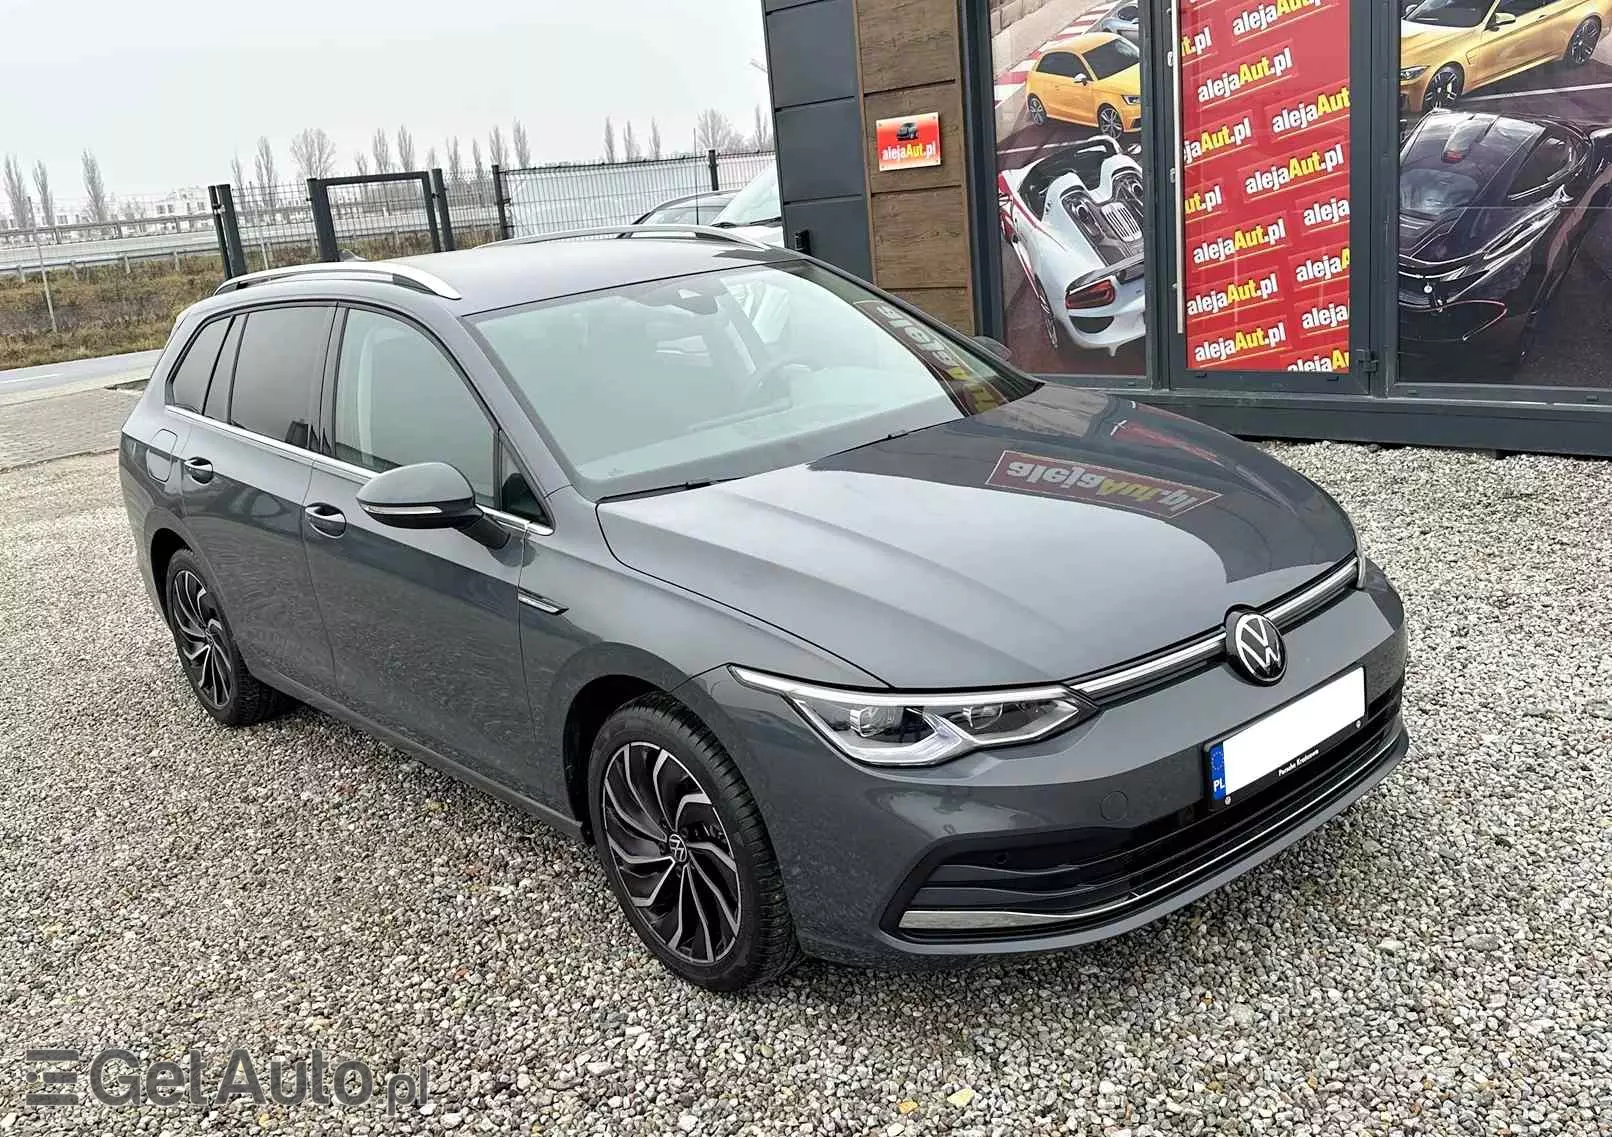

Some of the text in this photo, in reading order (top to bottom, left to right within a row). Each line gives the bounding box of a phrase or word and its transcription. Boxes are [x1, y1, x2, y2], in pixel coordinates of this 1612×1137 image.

[1181, 27, 1212, 56] t.pl
[1198, 48, 1292, 101] alejaAut.pl
[882, 141, 937, 160] alejaAut.pl
[1245, 144, 1344, 193] alejaAut.pl
[1303, 196, 1349, 225] aleja
[1193, 218, 1286, 263] alejaAut.pl
[1187, 273, 1278, 315] alejaAut.pl
[1302, 303, 1348, 329] aleja
[1194, 322, 1286, 361] alejaAut.pl
[1213, 777, 1225, 792] PL
